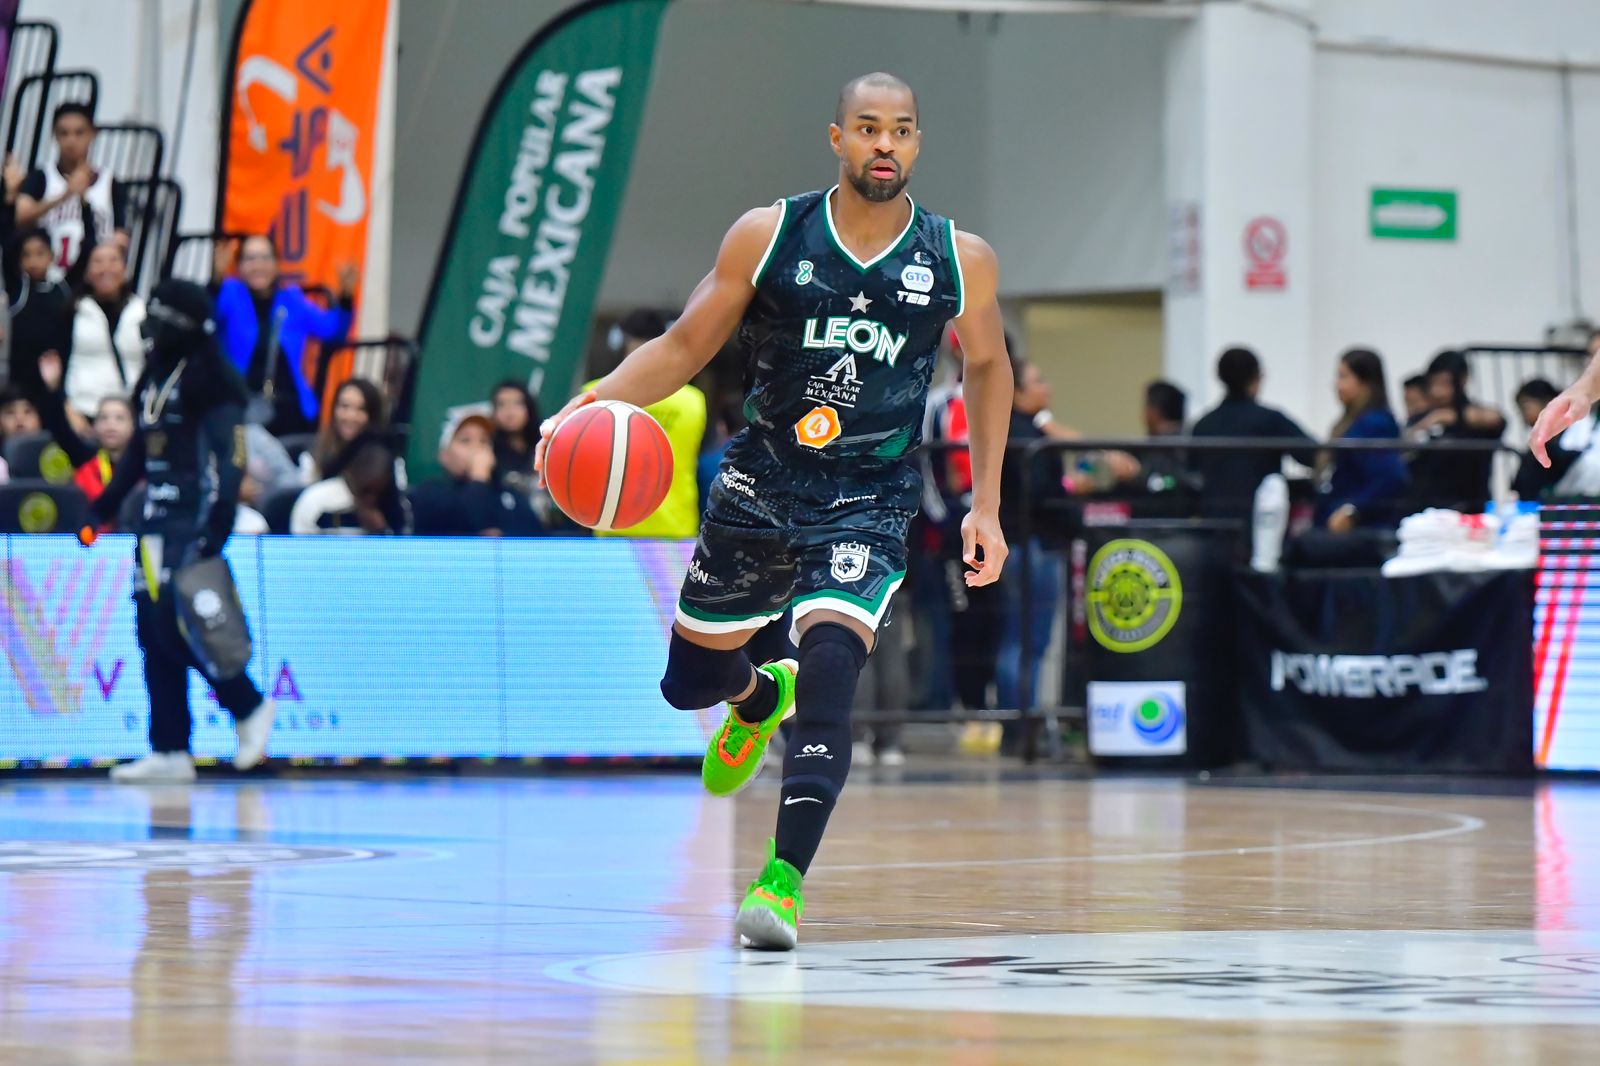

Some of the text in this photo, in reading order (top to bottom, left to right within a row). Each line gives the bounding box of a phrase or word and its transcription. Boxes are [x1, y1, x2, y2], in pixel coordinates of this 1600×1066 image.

[469, 69, 569, 348] CAJA POPULAR
[506, 66, 623, 363] MEXICANA
[795, 260, 814, 285] 8
[905, 271, 931, 283] GTO
[802, 316, 907, 368] LEÓN
[808, 381, 824, 390] CAJA
[809, 417, 822, 435] 4
